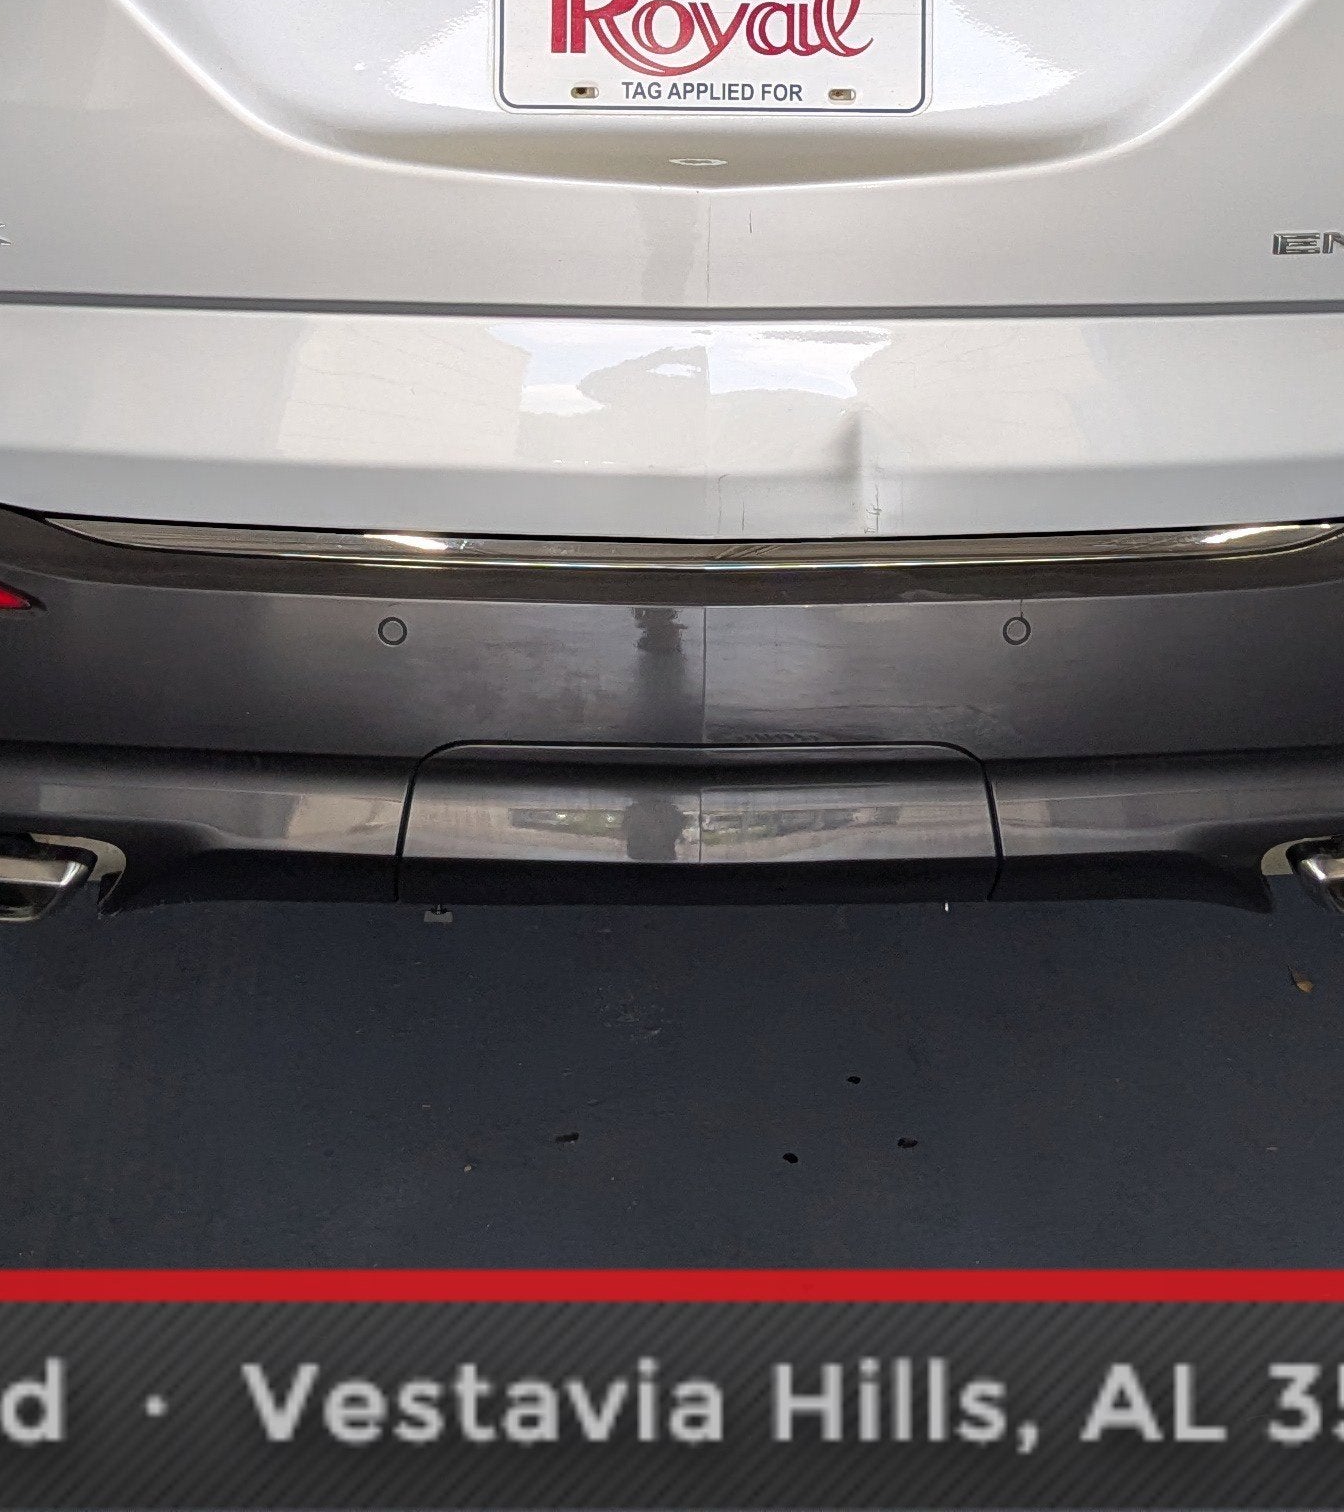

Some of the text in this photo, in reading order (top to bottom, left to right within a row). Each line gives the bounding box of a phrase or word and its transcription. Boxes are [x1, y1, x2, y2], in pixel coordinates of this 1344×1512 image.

[621, 81, 803, 102] TAG APPLIED FOR
